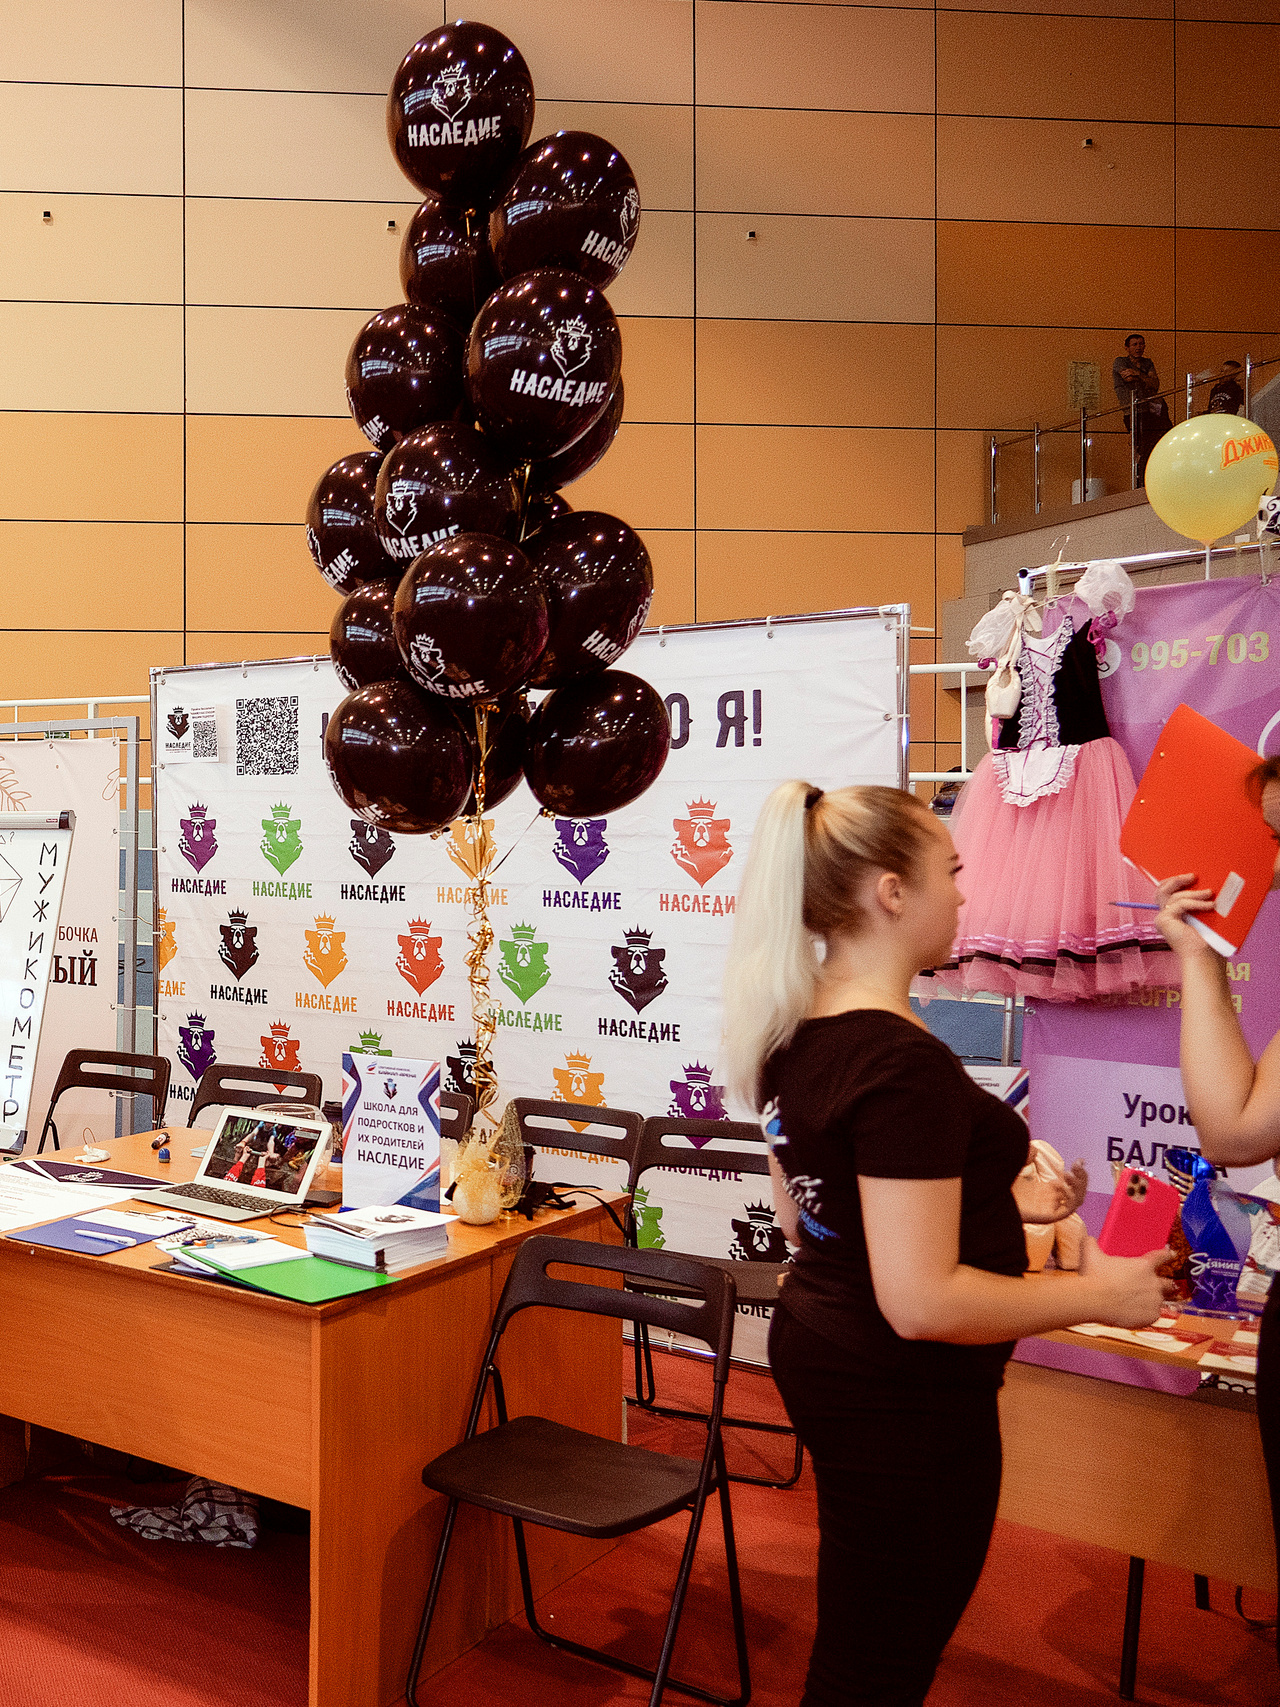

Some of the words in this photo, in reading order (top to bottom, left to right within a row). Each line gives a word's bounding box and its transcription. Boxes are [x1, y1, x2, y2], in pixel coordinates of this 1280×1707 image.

[408, 116, 501, 147] НАСЛЕДИЕ
[581, 230, 629, 268] НАСЛЕ
[510, 368, 608, 407] НАСЛЕДИЕ
[1131, 631, 1270, 672] 995-703
[715, 689, 763, 750] Я!
[9, 831, 15, 845] ?
[171, 878, 227, 897] НАСЛЕДИЕ
[252, 881, 313, 900] НАСЛЕДИЕ
[340, 884, 406, 904] НАСЛЕДИЕ
[542, 889, 622, 912] НАСЛЕДИЕ
[659, 893, 736, 917] НАСЛЕДИ
[49, 949, 99, 987] ЫЙ
[210, 984, 268, 1005] НАСЛЕДИЕ
[295, 992, 358, 1014] НАСЛЕДИЕ
[387, 1000, 455, 1023] НАСЛЕДИЕ
[598, 1017, 681, 1043] НАСЛЕДИЕ
[363, 1101, 397, 1113] ШКОЛА
[398, 1106, 419, 1116] ДЛЯ
[357, 1117, 415, 1133] ПОДРОСТКОВ
[417, 1125, 425, 1133] И
[357, 1134, 370, 1143] ИХ
[372, 1135, 424, 1151] РОДИТЕЛЕЙ
[357, 1149, 425, 1170] НАСЛЕДИЕ
[1106, 1136, 1228, 1178] БАЛ
